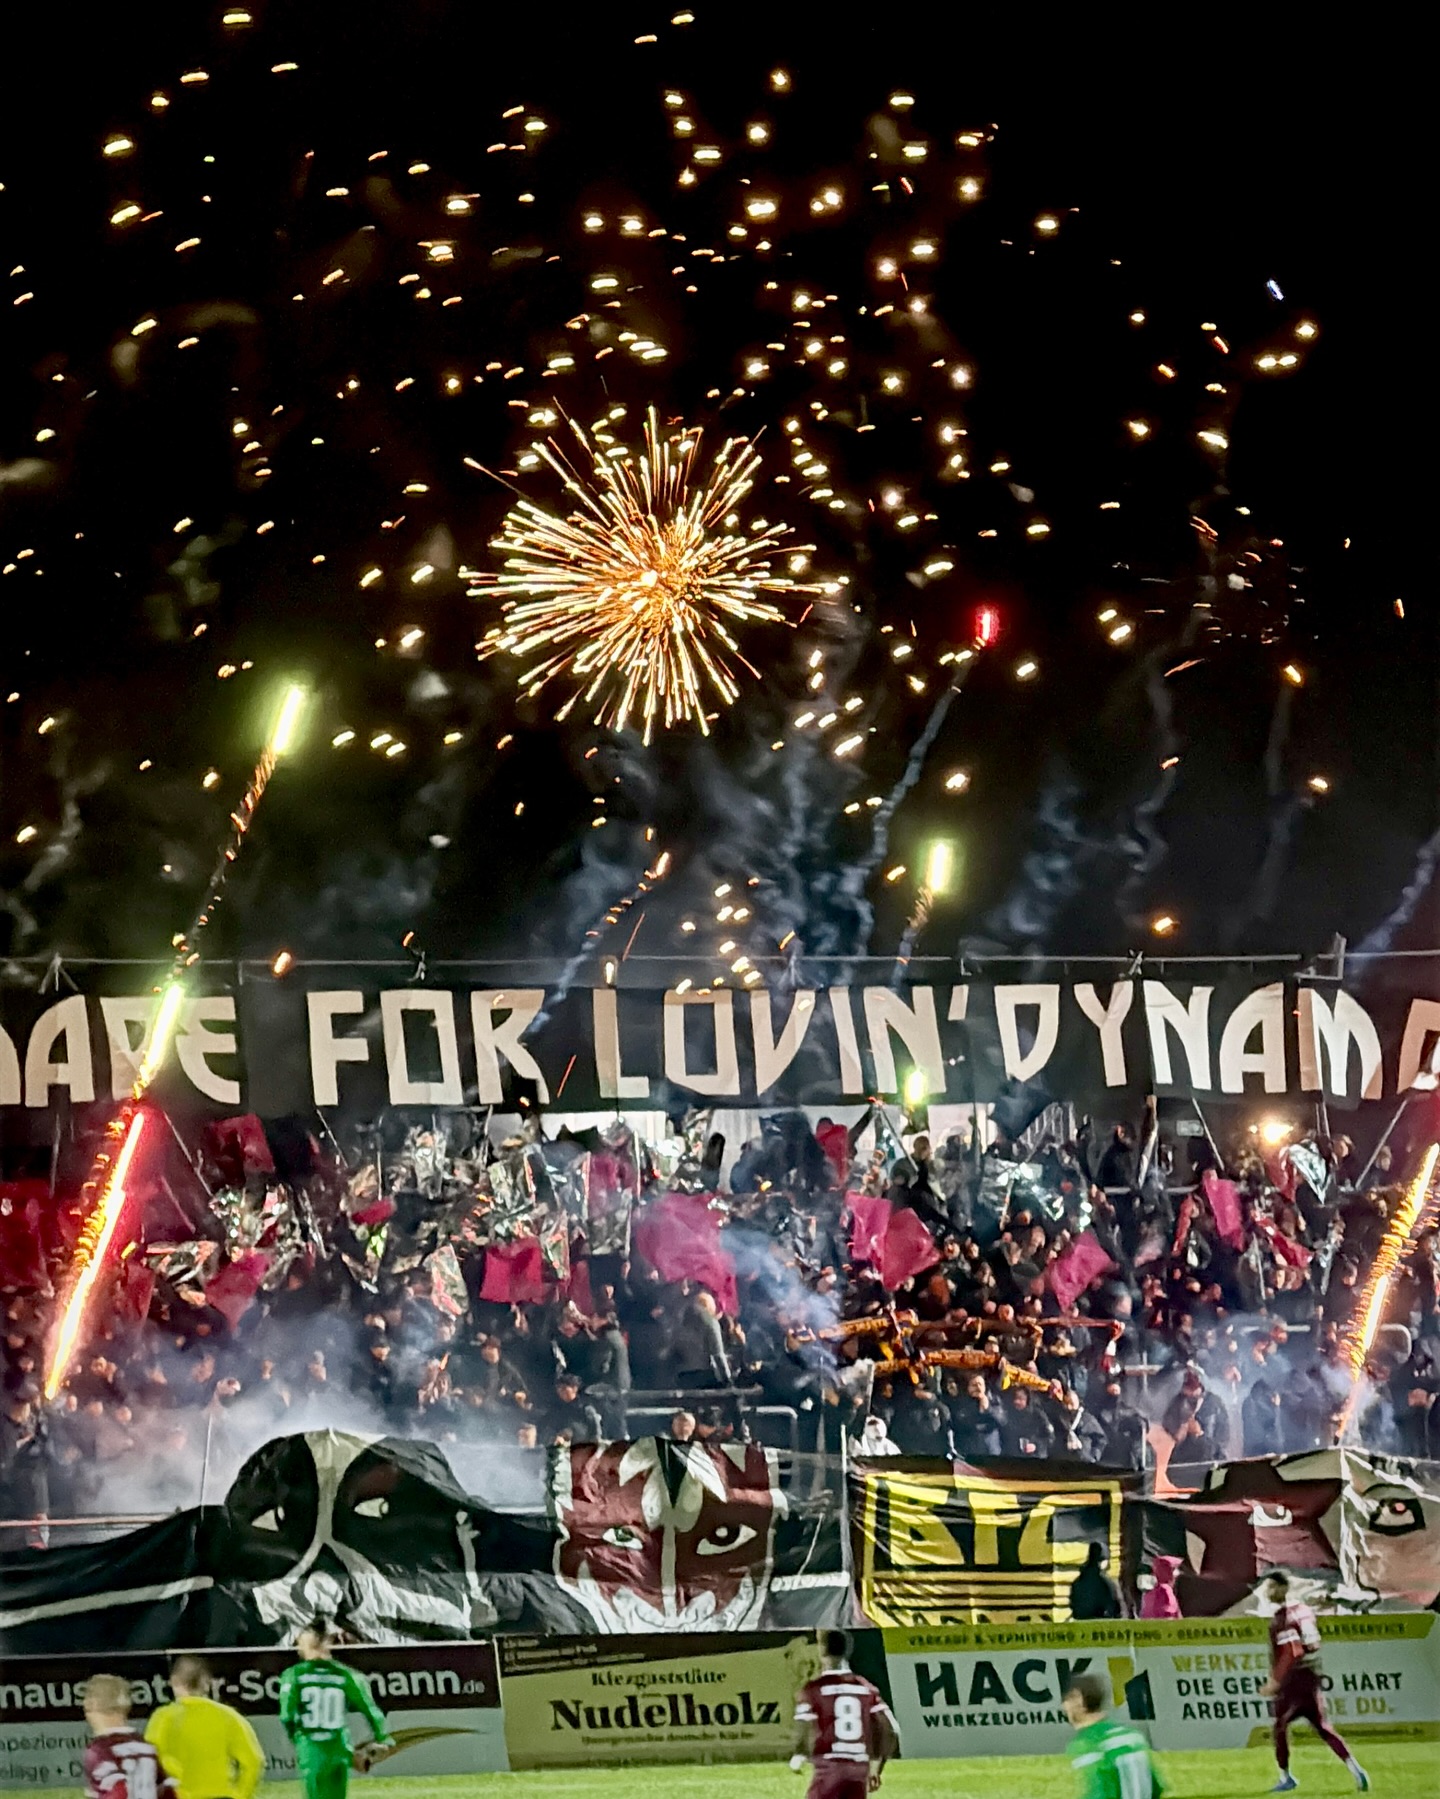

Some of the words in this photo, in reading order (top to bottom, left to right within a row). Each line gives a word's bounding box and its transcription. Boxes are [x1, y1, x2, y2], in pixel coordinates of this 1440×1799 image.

[306, 989, 550, 1106] FOR
[593, 985, 968, 1099] LOVIN'
[1171, 1653, 1267, 1673] WERKZE
[914, 1656, 1092, 1708] HACK
[1176, 1678, 1215, 1697] DIE
[1223, 1676, 1268, 1695] GEN
[1342, 1671, 1402, 1692] HART
[301, 1686, 346, 1729] 30
[550, 1692, 781, 1731] Nudelholz
[834, 1696, 862, 1740] 8
[922, 1711, 1071, 1729] WERKZEUGHAN
[1182, 1700, 1276, 1721] ARBEIT
[1356, 1696, 1395, 1716] DU.
